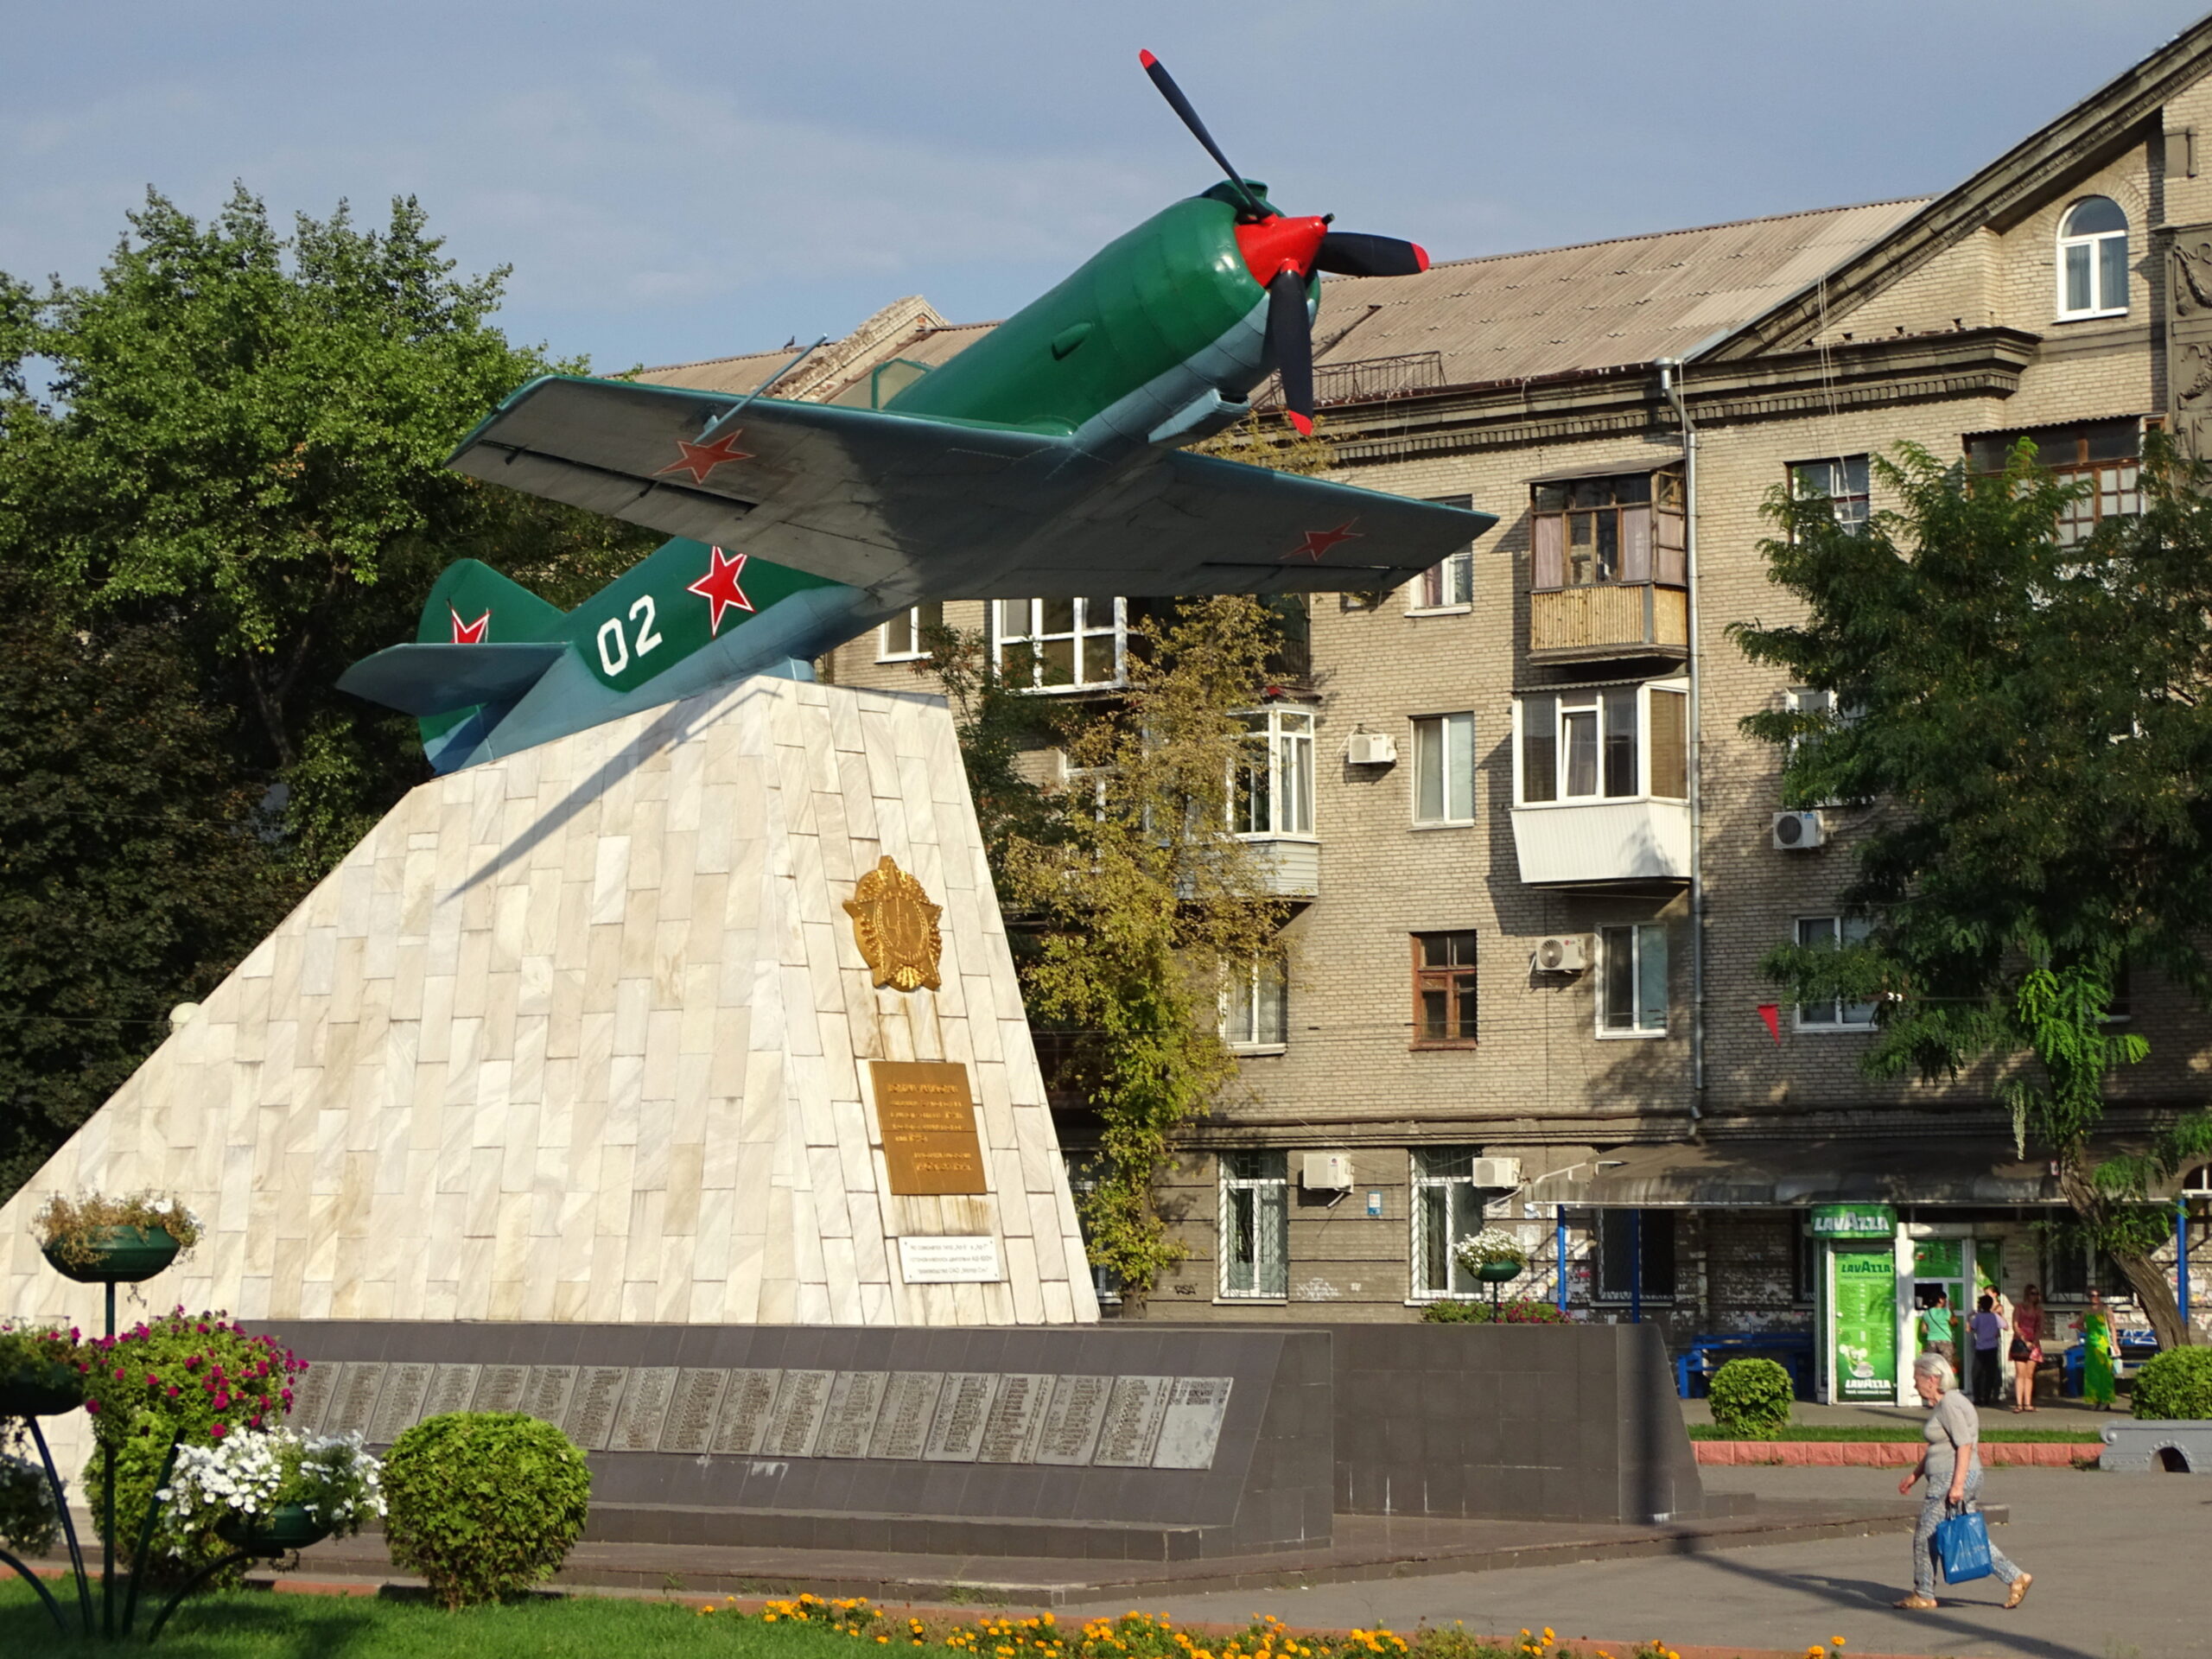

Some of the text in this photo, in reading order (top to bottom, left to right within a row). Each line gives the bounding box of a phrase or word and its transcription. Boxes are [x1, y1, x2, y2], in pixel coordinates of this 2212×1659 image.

[596, 594, 664, 677] 02
[1814, 1211, 1891, 1230] LAVAZZA
[1841, 1261, 1891, 1273] LAVAZZA
[1845, 1378, 1891, 1389] LAVAZZA
